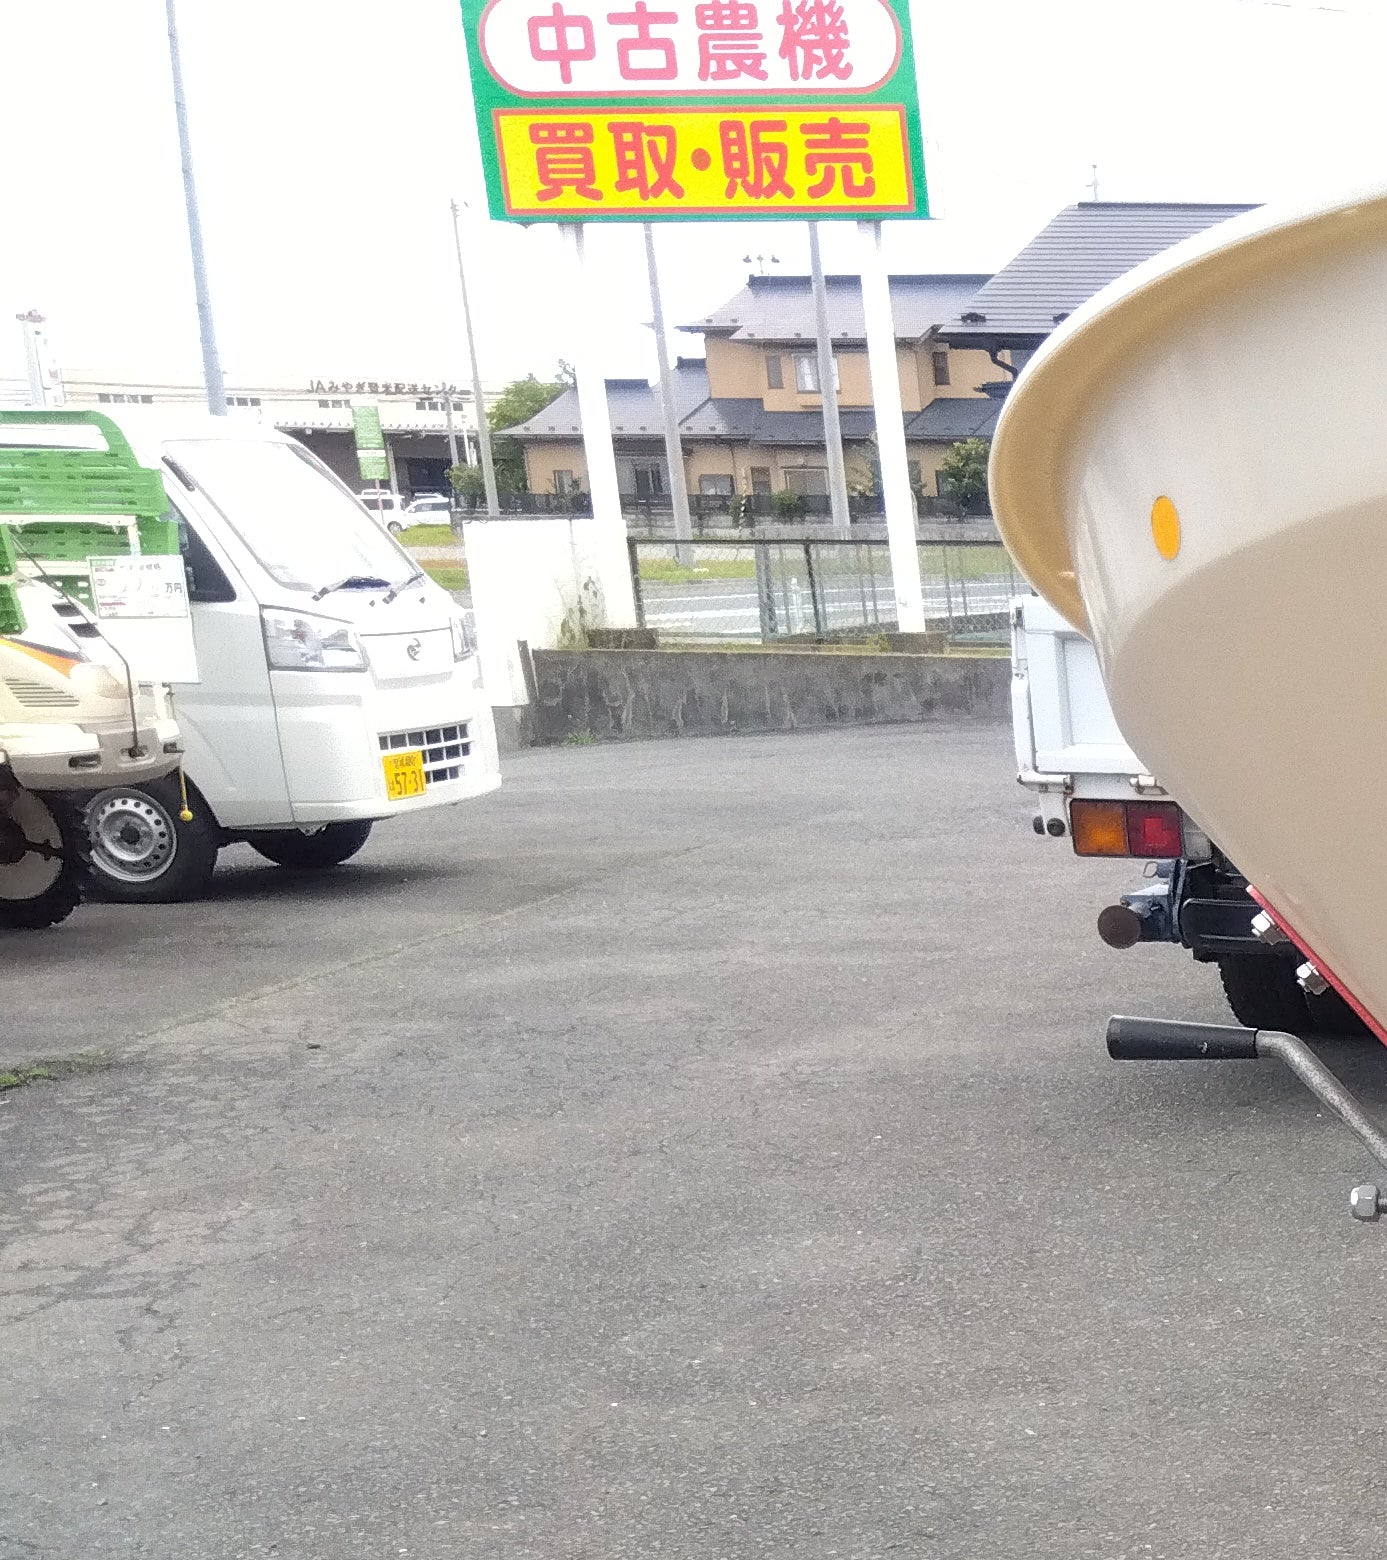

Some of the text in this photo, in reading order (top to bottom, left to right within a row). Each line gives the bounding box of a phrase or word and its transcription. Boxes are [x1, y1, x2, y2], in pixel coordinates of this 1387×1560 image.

[527, 0, 854, 84] 中古農機
[528, 117, 877, 202] 買取・販売
